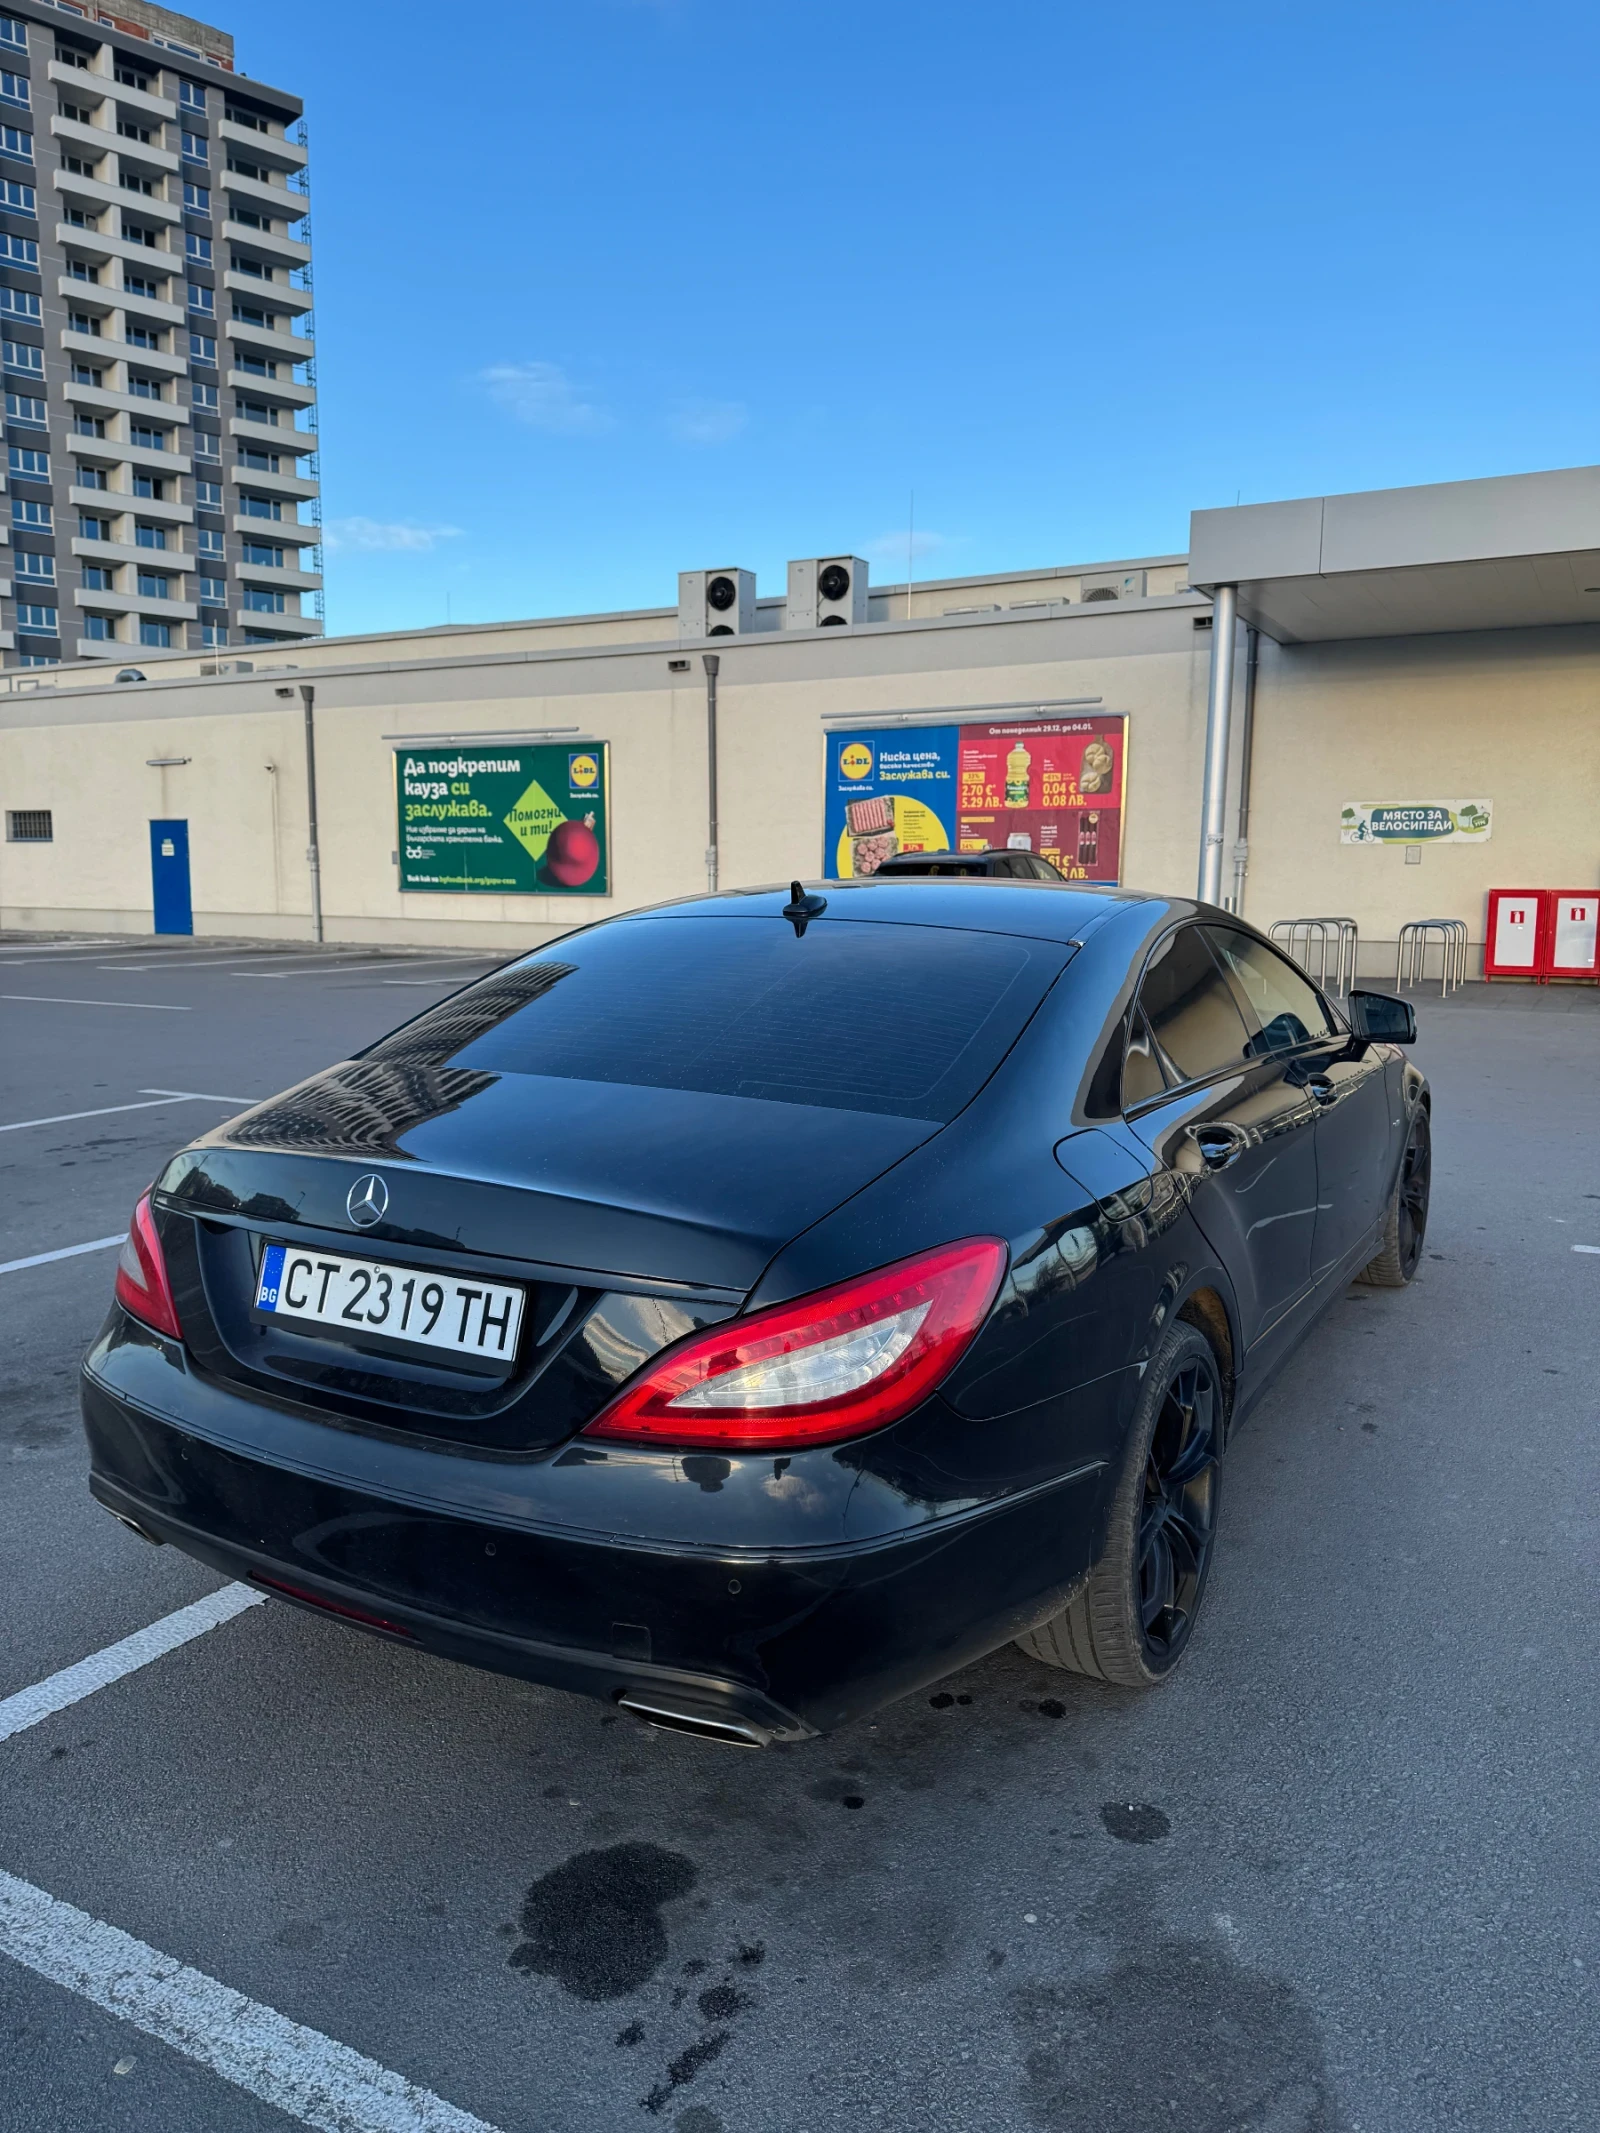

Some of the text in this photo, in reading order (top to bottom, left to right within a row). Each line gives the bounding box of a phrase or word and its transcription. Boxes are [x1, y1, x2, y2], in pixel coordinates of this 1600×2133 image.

[1062, 724, 1071, 733] до
[880, 751, 940, 763] Ниска цена,
[404, 756, 521, 778] Да подкрепим
[880, 769, 951, 782] Заслужава си.
[404, 778, 470, 800] кауза си
[962, 785, 984, 796] 2.70
[1043, 782, 1077, 794] 0.04 €
[961, 796, 1003, 808] 5.29 ЛВ.
[1043, 794, 1087, 807] 0.08 ЛВ.
[404, 799, 493, 821] заслужава.
[509, 808, 562, 822] Помогни
[1382, 810, 1442, 820] МЯСТО ЗА
[520, 820, 553, 836] и ти!
[1371, 820, 1453, 832] ВЕЛОСИПЕДИ
[260, 1286, 278, 1304] BG
[285, 1258, 513, 1351] CT 2319 TH
